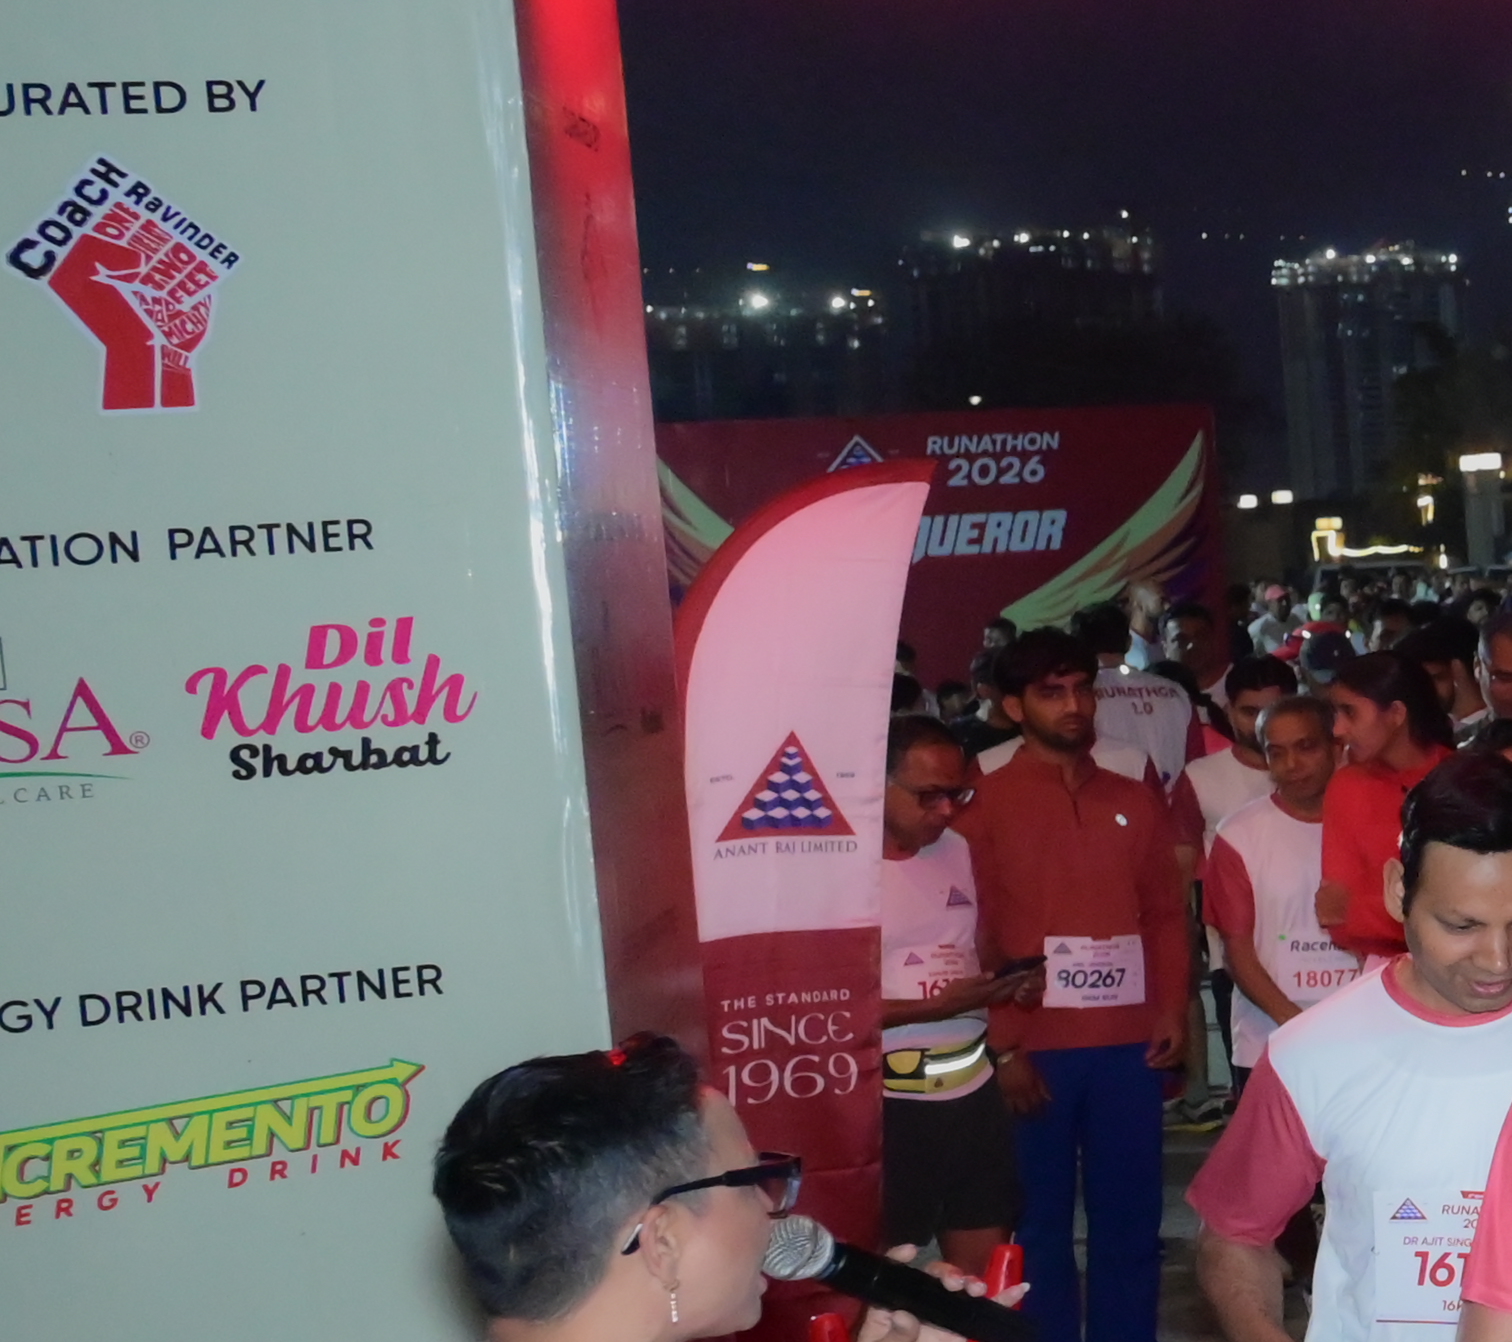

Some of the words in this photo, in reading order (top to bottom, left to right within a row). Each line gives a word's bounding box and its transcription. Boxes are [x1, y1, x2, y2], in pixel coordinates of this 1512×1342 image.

[206, 79, 266, 113] BY
[92, 201, 142, 241] ONE
[926, 430, 1060, 456] RUNATHON
[946, 455, 1047, 487] 2026
[0, 530, 141, 570] ATION
[167, 518, 375, 560] PARTNER
[304, 615, 415, 670] Dil
[184, 652, 478, 741] Khush
[228, 731, 451, 781] Sharbat
[13, 782, 95, 805] CARE
[713, 841, 770, 861] ANANT
[775, 841, 797, 856] RAJ
[800, 839, 858, 855] LIMITED
[0, 996, 62, 1034] GY
[78, 982, 227, 1028] DRINK
[239, 963, 444, 1013] PARTNER
[721, 995, 757, 1013] THE
[765, 988, 851, 1007] STANDARD
[720, 1012, 854, 1055] SINCE
[722, 1052, 859, 1108] 1969
[0, 1080, 411, 1202] CREMENTO
[227, 1138, 402, 1189] DRINK
[1403, 1236, 1419, 1246] DR
[1421, 1236, 1445, 1247] AJIT
